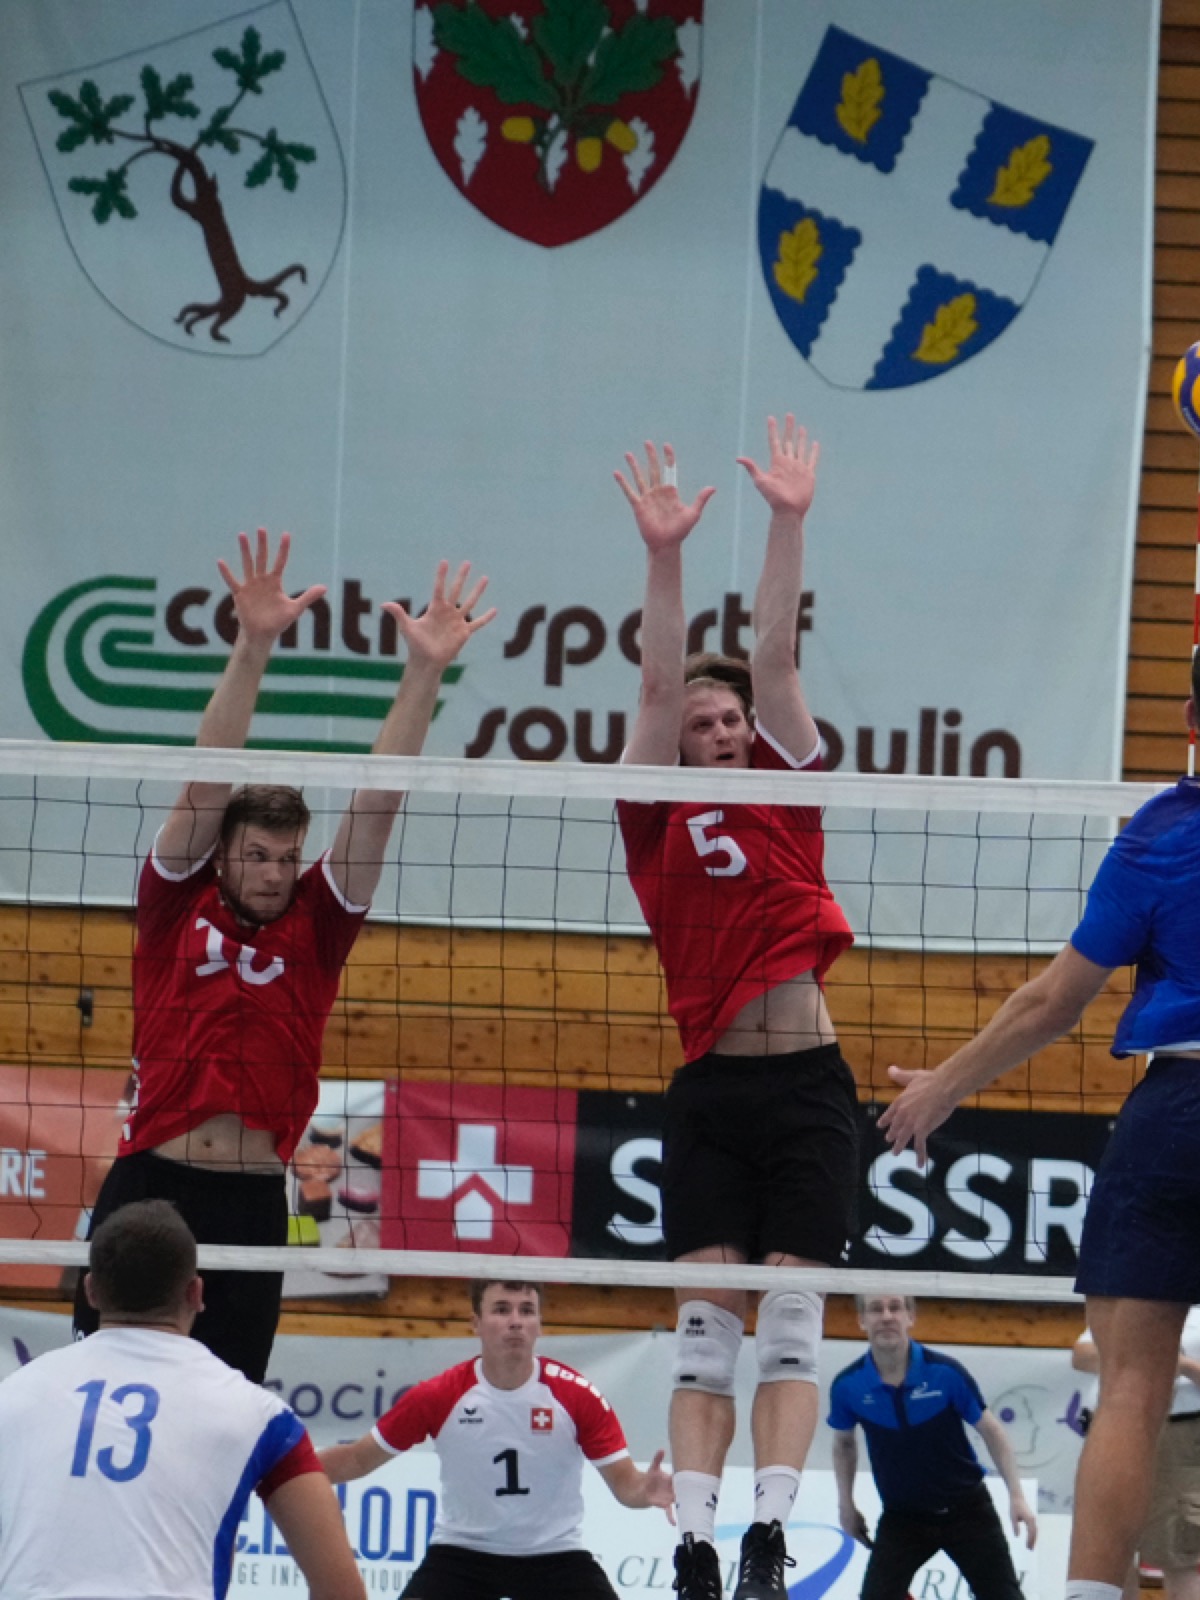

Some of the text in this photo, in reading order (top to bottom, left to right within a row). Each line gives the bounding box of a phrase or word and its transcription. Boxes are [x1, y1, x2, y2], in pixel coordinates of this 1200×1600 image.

[503, 590, 815, 687] sprtf
[686, 809, 747, 877] 5
[70, 1379, 160, 1483] 13
[492, 1447, 530, 1497] 1
